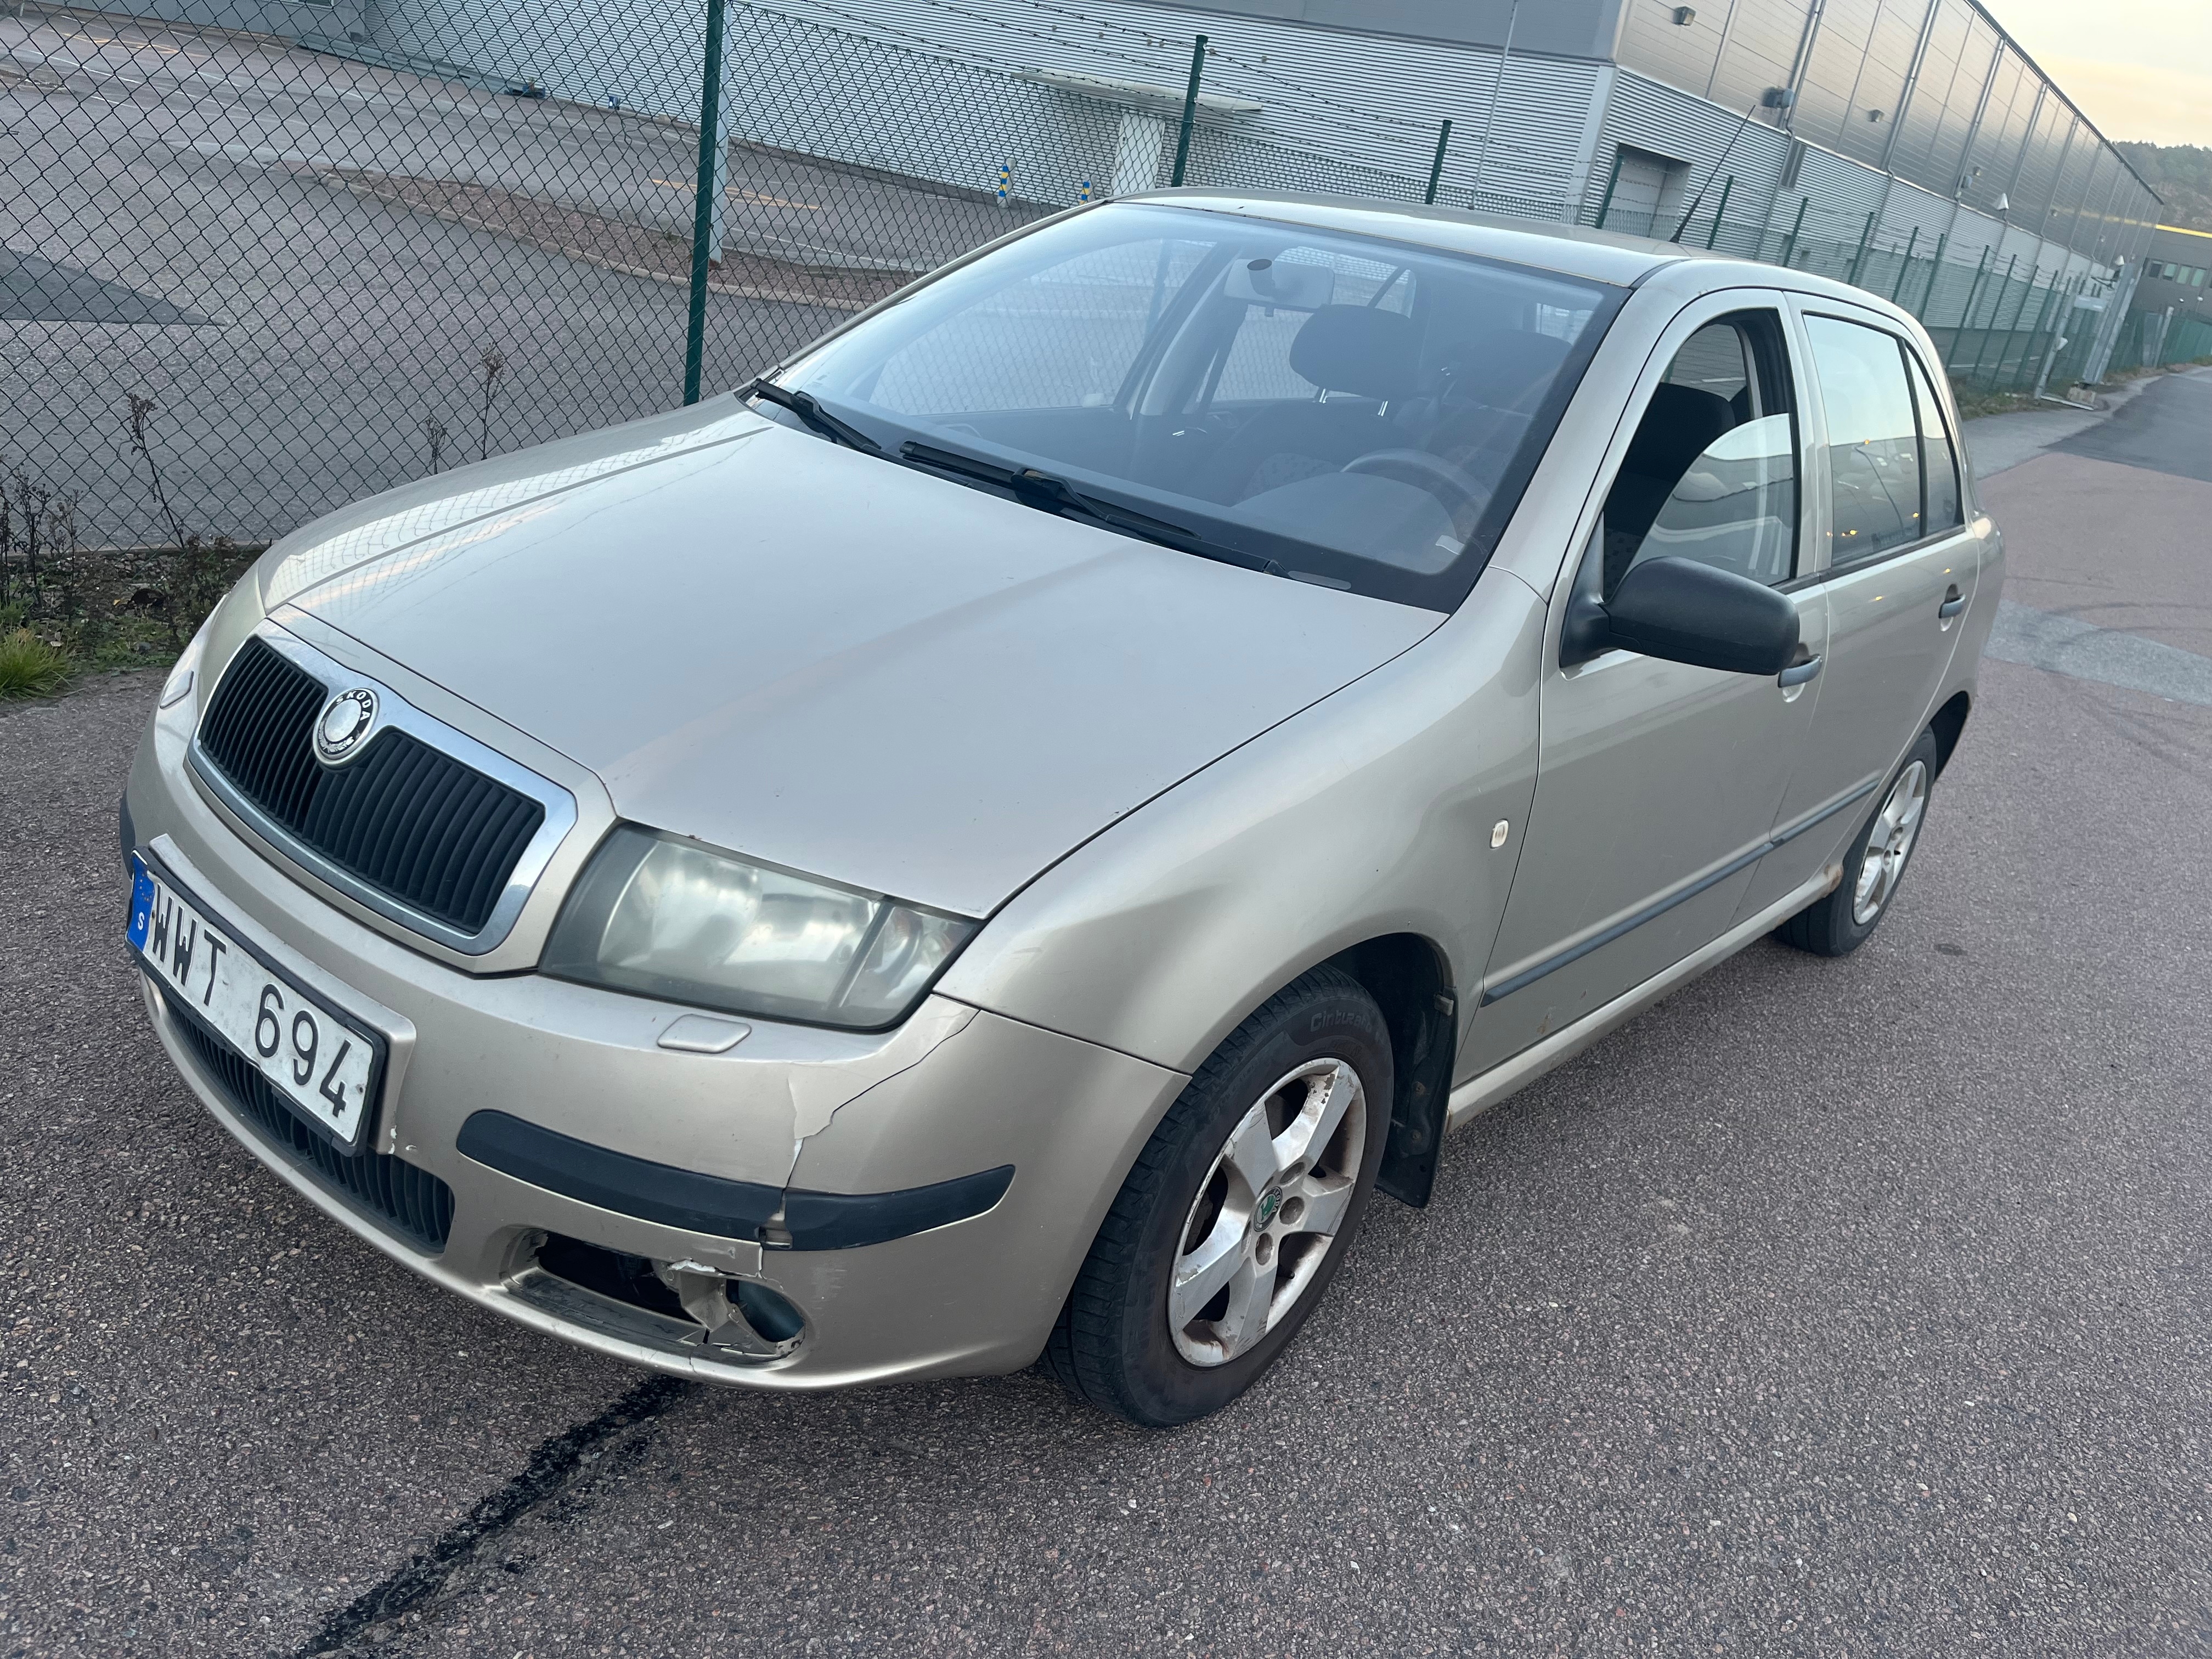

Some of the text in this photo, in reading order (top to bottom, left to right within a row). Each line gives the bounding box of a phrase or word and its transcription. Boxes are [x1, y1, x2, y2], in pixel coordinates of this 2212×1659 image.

[138, 912, 145, 930] S
[153, 883, 353, 1118] WWT 694
